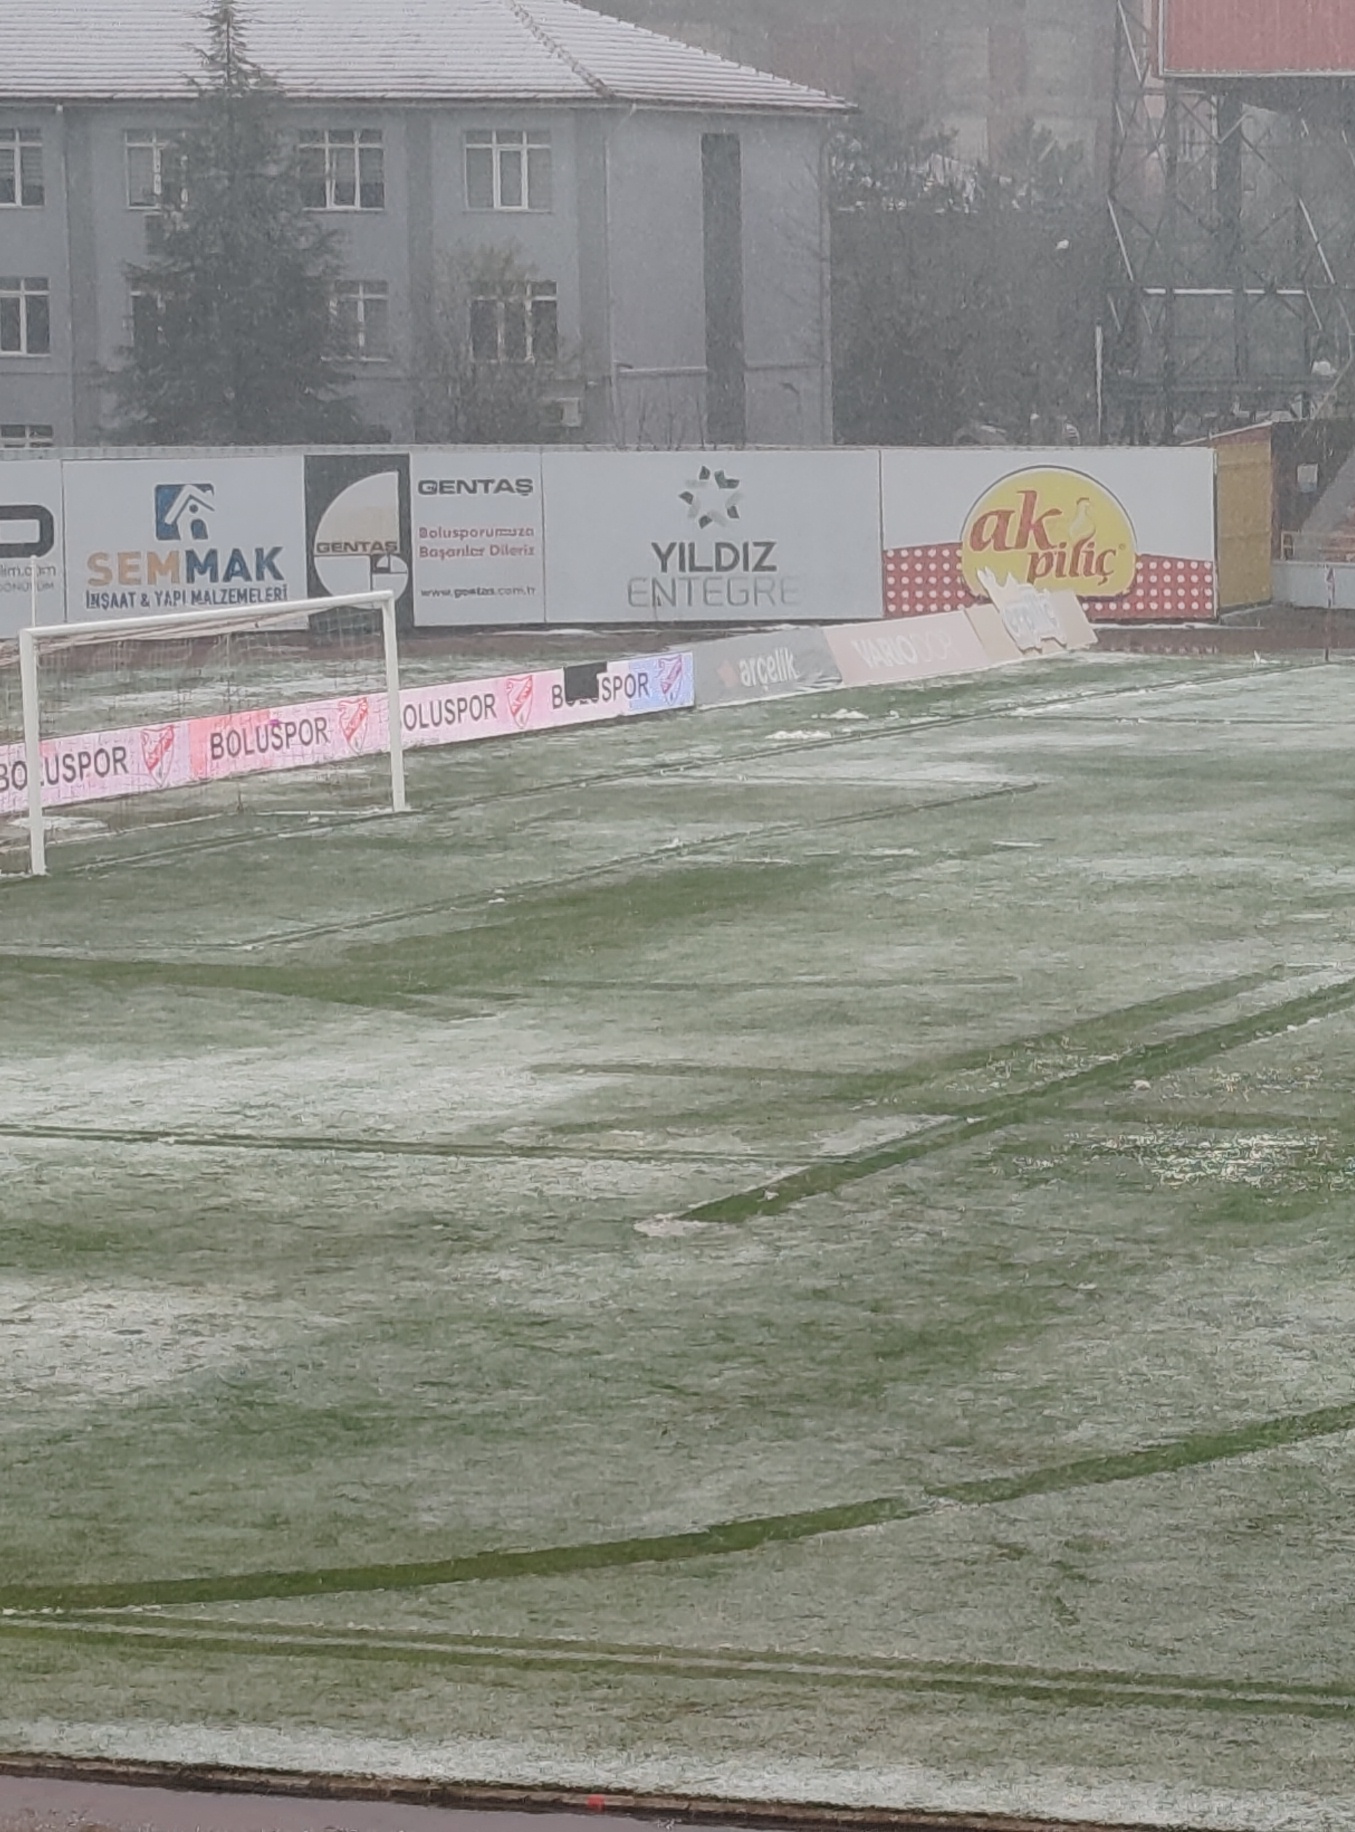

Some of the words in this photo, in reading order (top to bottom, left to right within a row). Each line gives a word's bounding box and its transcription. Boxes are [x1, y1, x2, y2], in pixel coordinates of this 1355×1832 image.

[417, 478, 534, 496] GENTAŞ
[968, 489, 1063, 552] ak
[86, 546, 286, 586] SEMMAK
[651, 540, 778, 573] YILDIZ
[1025, 535, 1117, 586] piliç
[86, 589, 136, 610] İNŞAAT
[140, 593, 150, 607] &
[154, 590, 186, 607] YAPI
[191, 583, 288, 606] MALZEMELERİ
[627, 575, 800, 607] ENTEGRE
[739, 647, 800, 690] arçelik
[210, 716, 330, 760] BOLUSPOR
[403, 693, 498, 731] OLUSPOR
